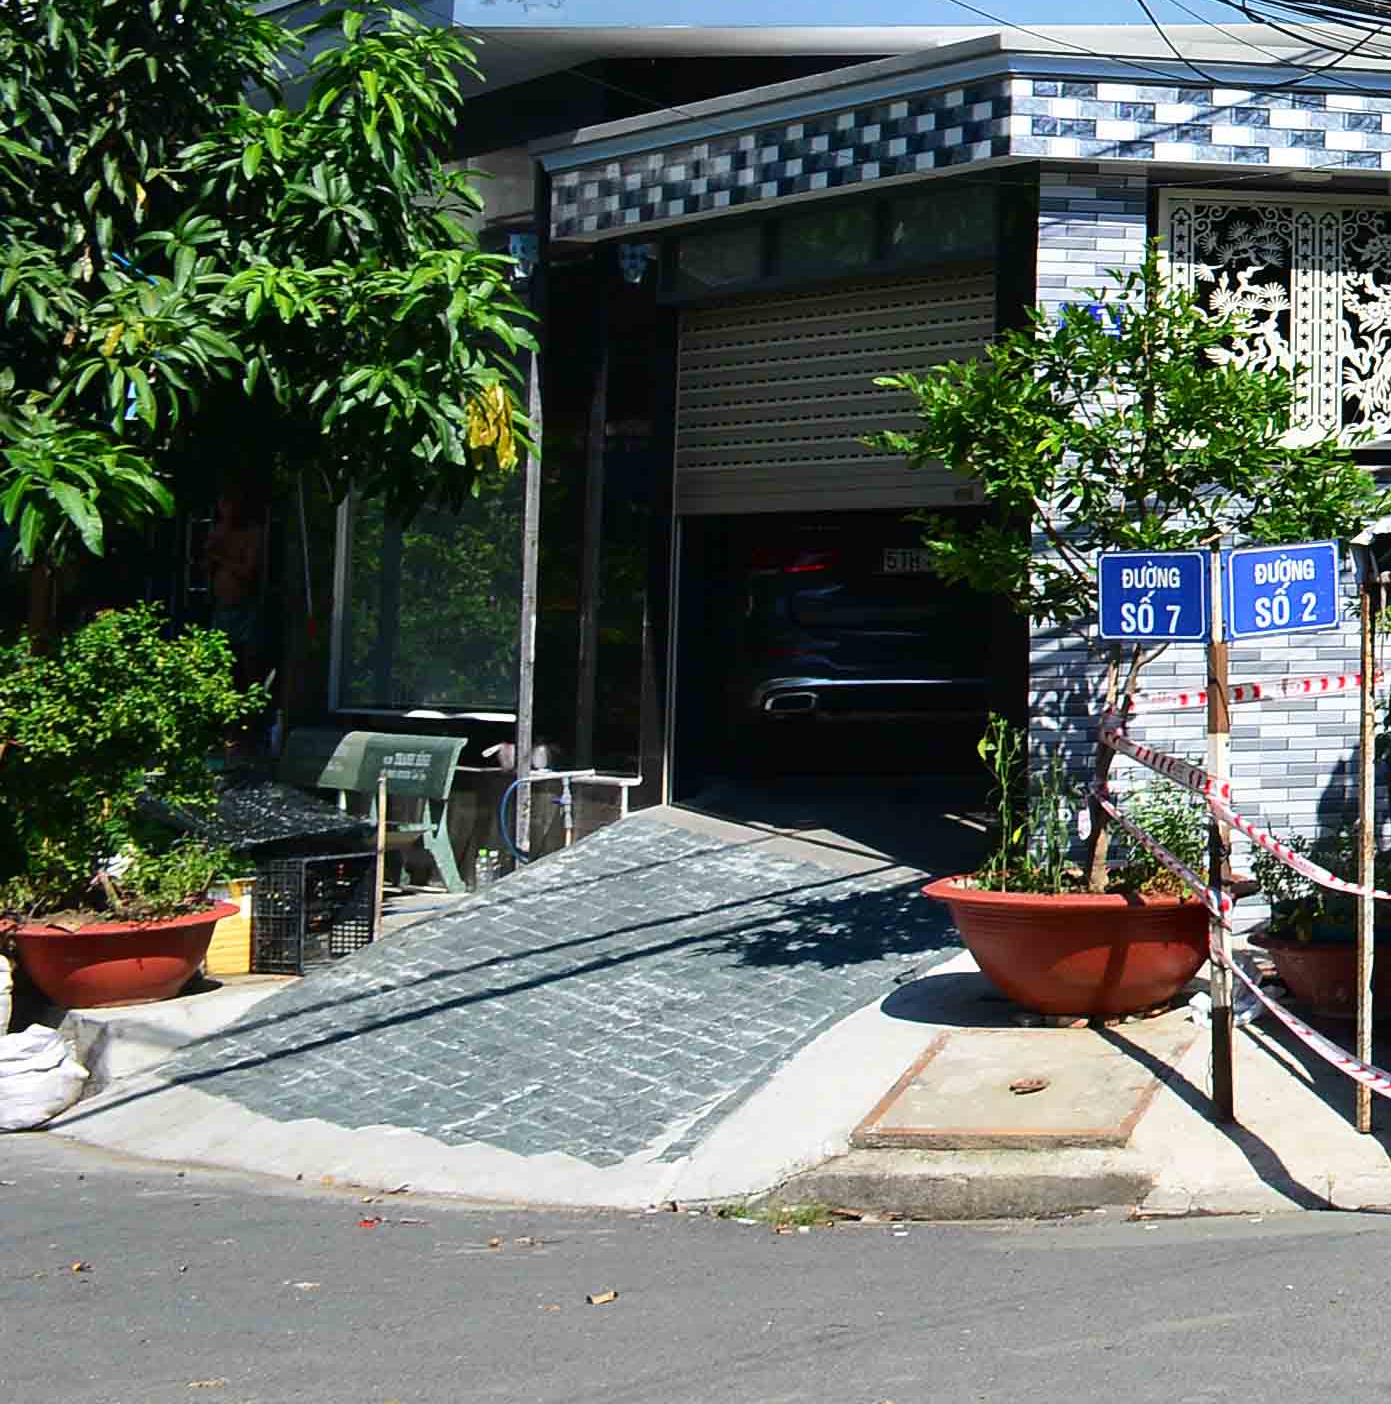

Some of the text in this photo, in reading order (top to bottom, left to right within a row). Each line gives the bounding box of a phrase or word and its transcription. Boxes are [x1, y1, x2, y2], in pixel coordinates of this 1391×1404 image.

[1121, 561, 1181, 589] ĐƯỜNG
[1254, 554, 1315, 585] ĐƯỜNG
[1120, 591, 1181, 634] SỐ 7
[1254, 582, 1317, 629] SỐ 2
